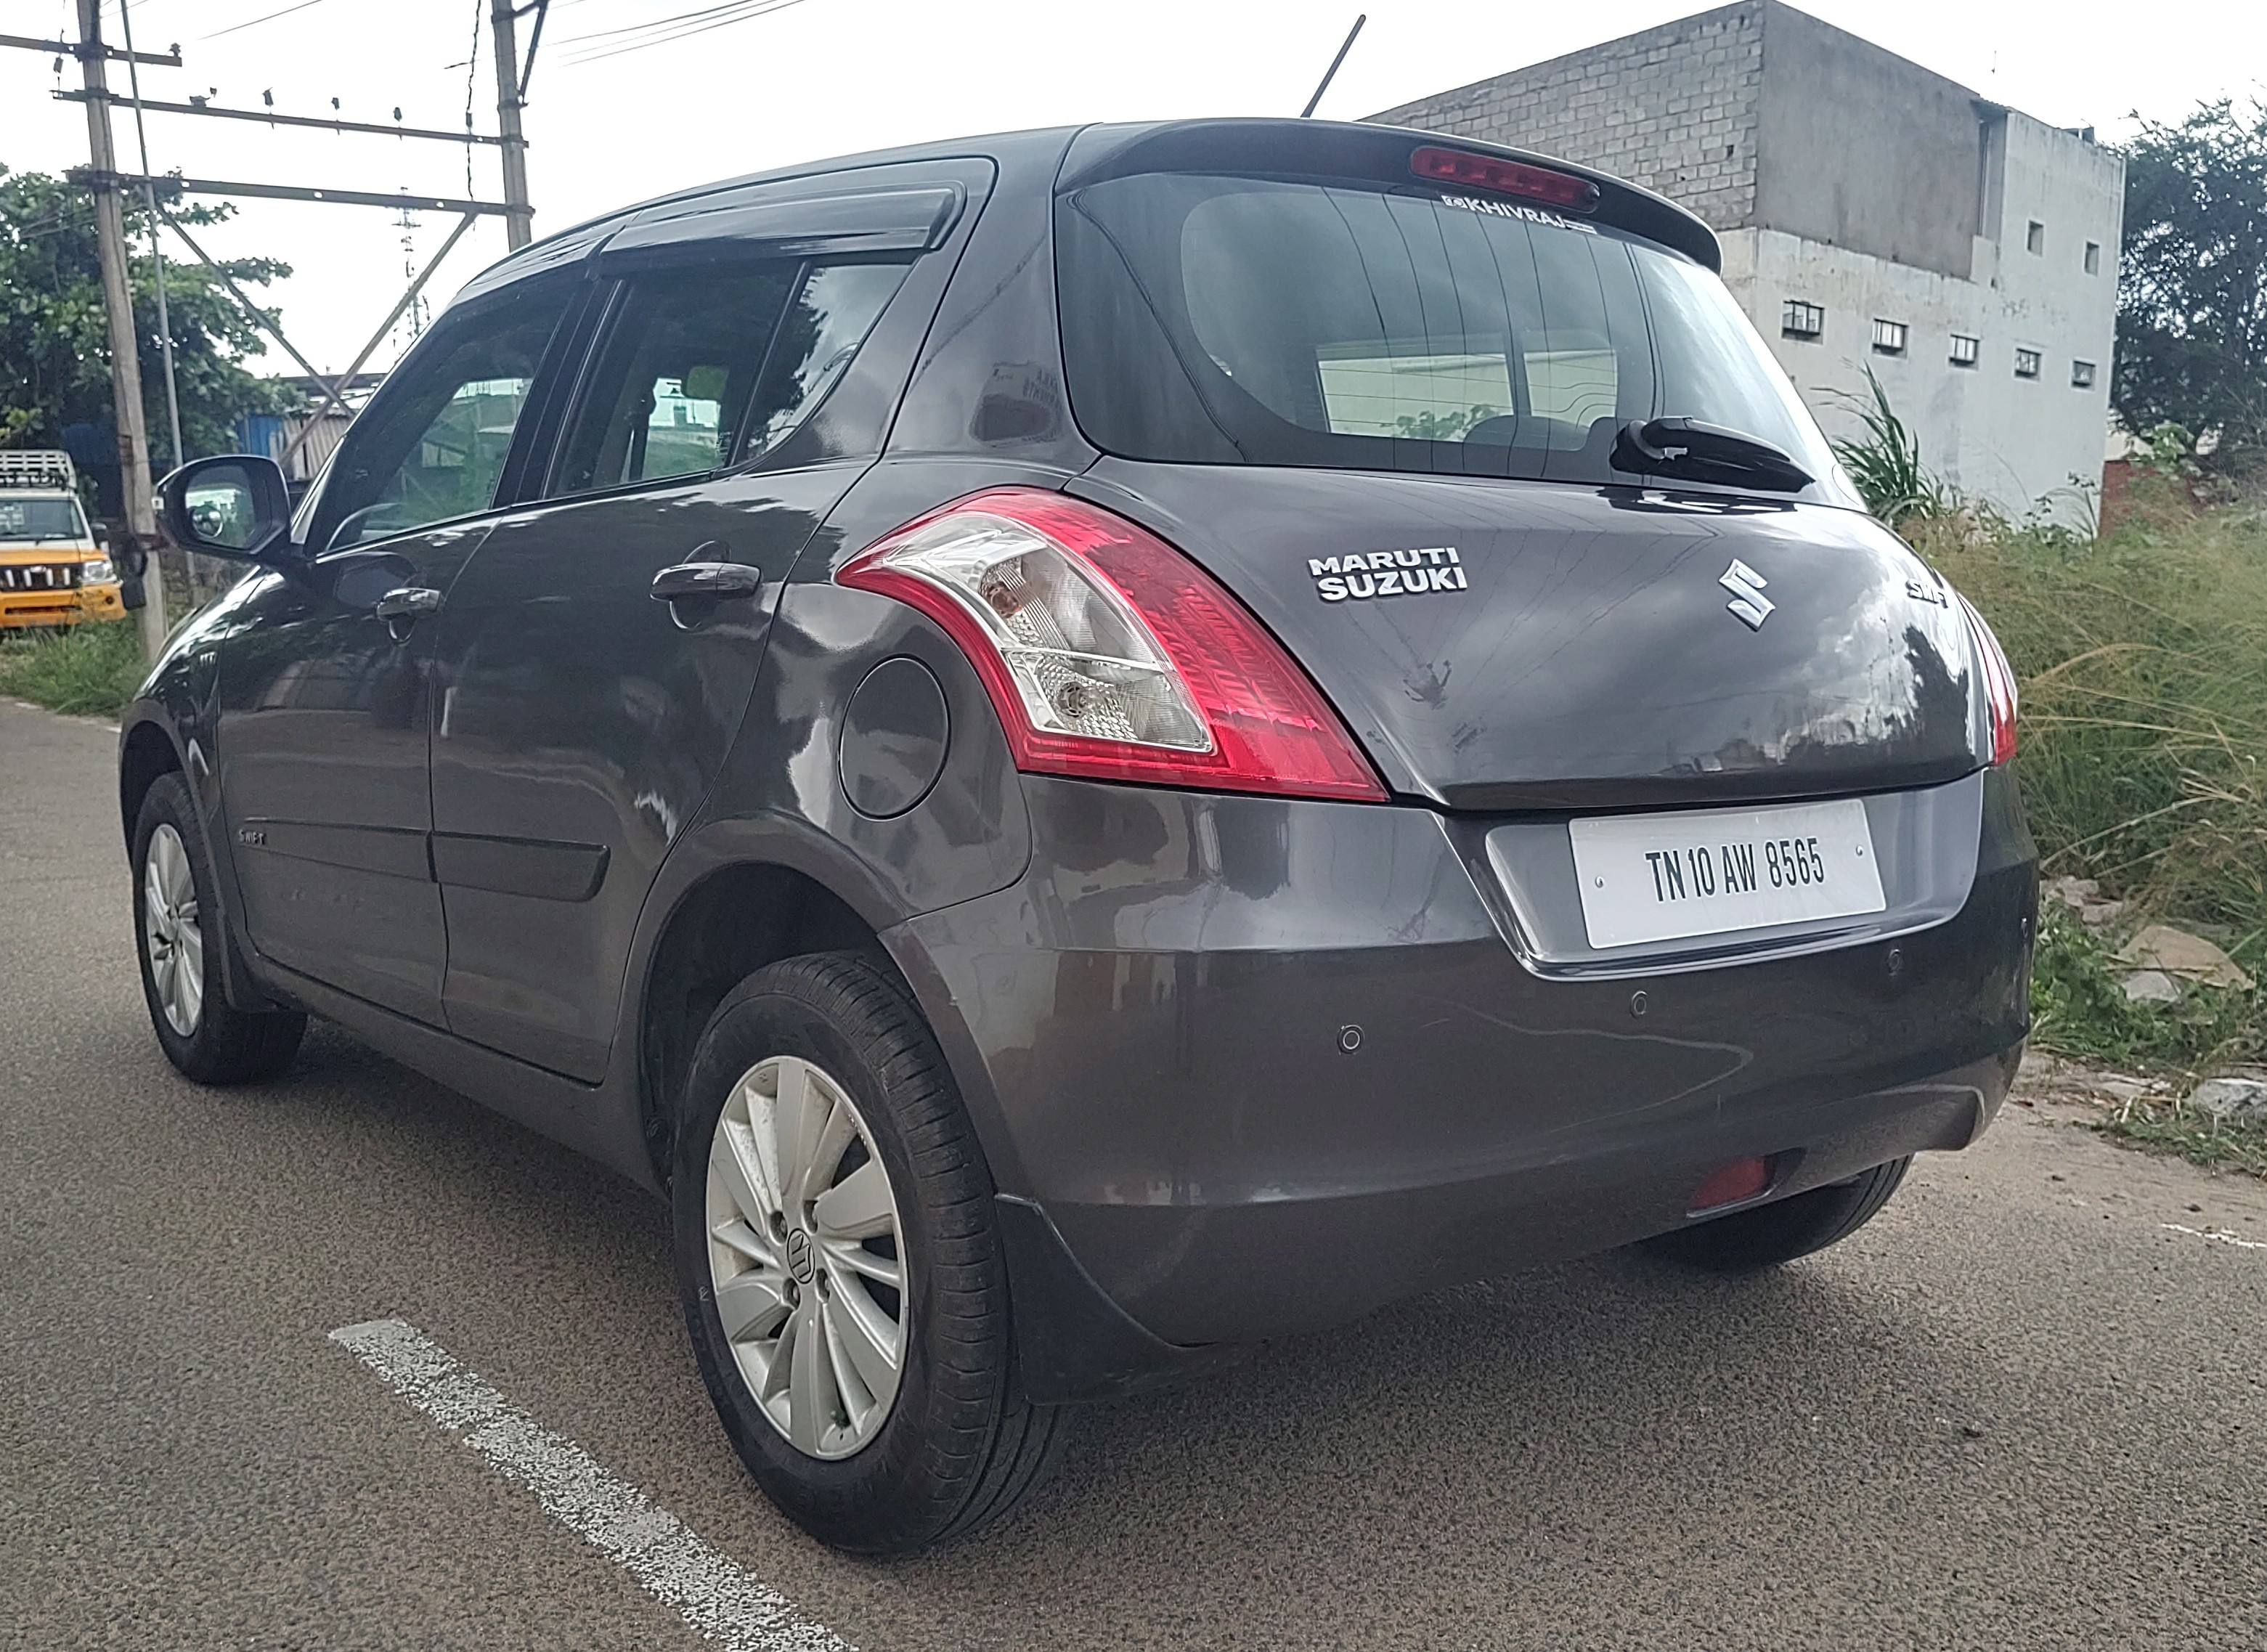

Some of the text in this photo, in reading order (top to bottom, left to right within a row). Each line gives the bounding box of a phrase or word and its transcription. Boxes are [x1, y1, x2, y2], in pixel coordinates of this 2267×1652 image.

[1464, 197, 1566, 229] KHIVRAJ
[1308, 548, 1460, 575] MARUTI
[1318, 567, 1468, 601] SUZUKI
[1645, 837, 1824, 902] TN 10 AW 8565
